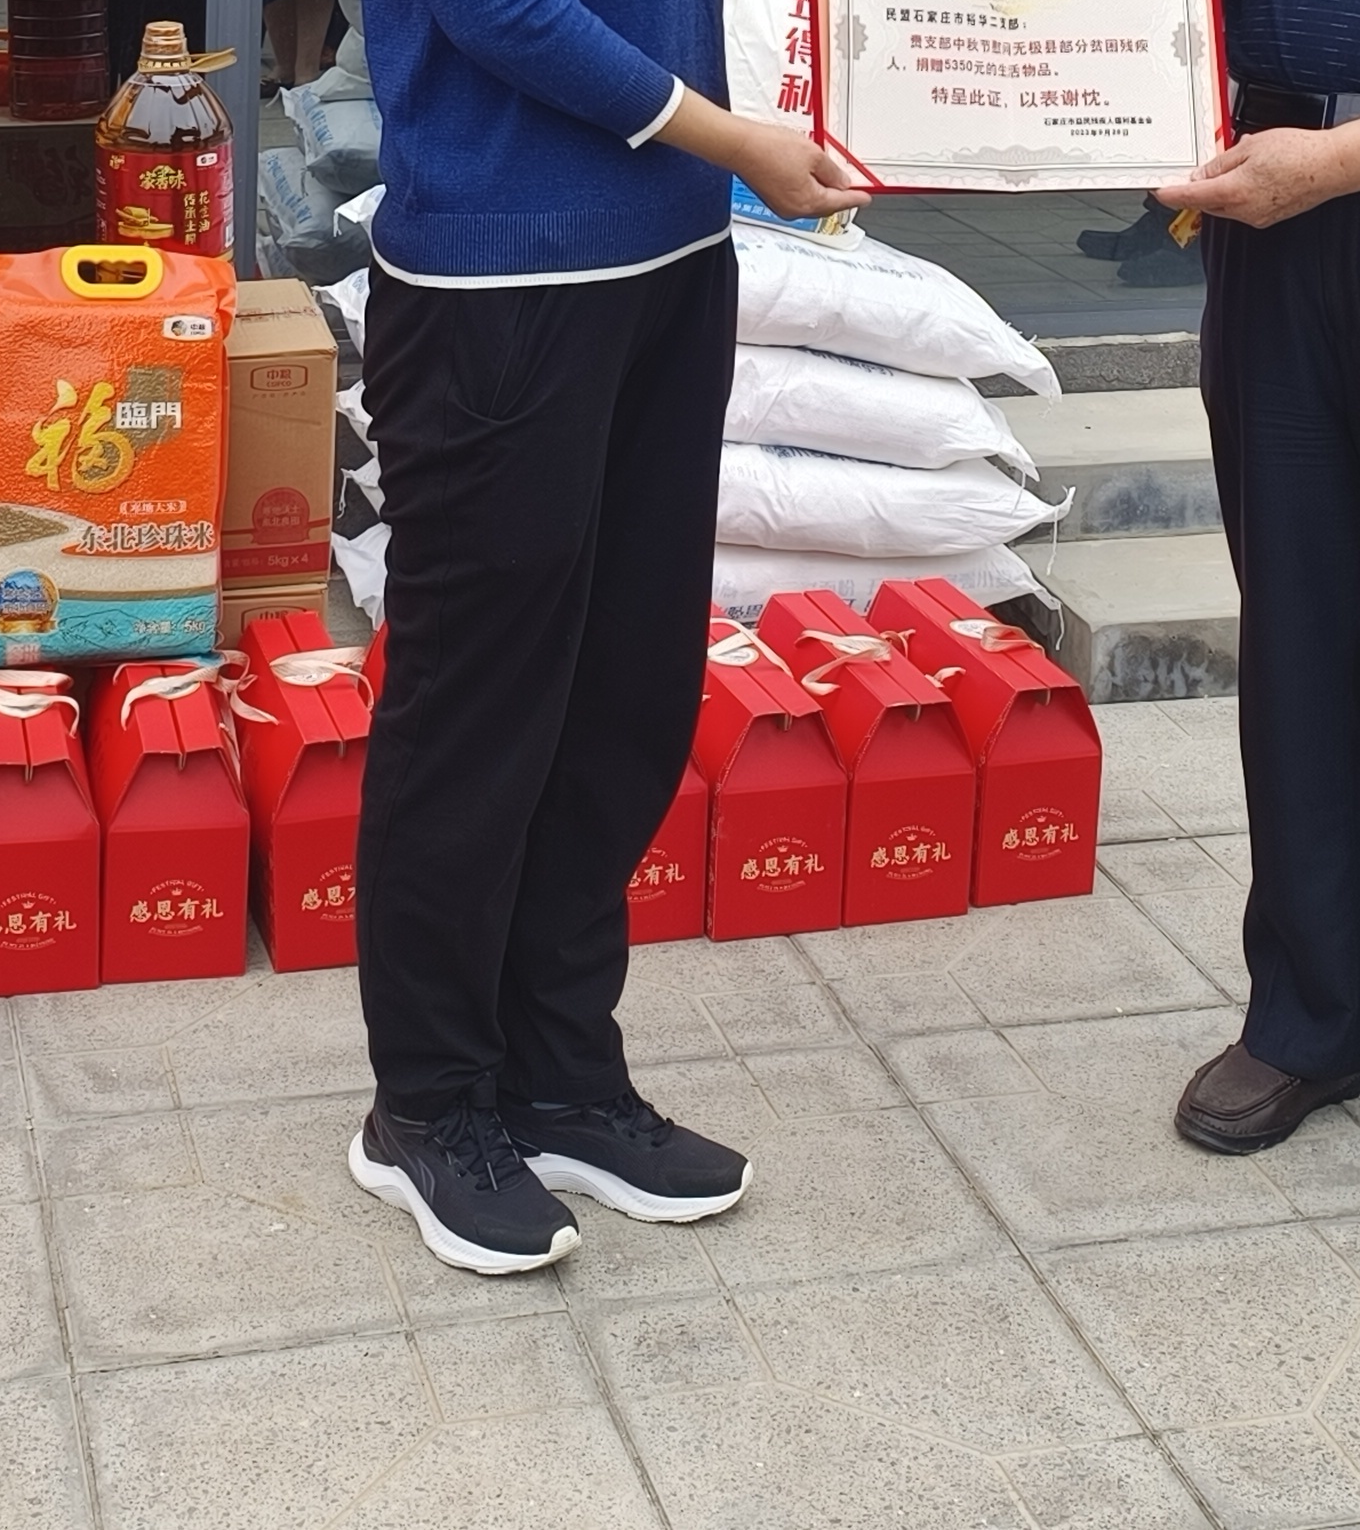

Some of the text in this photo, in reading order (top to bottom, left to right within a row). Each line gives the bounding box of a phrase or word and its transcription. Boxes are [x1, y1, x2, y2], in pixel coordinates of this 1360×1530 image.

[81, 523, 213, 552] 东北珍珠米
[1002, 823, 1079, 850] 感恩有礼
[740, 853, 825, 880] 感恩有礼
[870, 842, 951, 868] 感恩有礼
[129, 898, 224, 923] 感恩有礼
